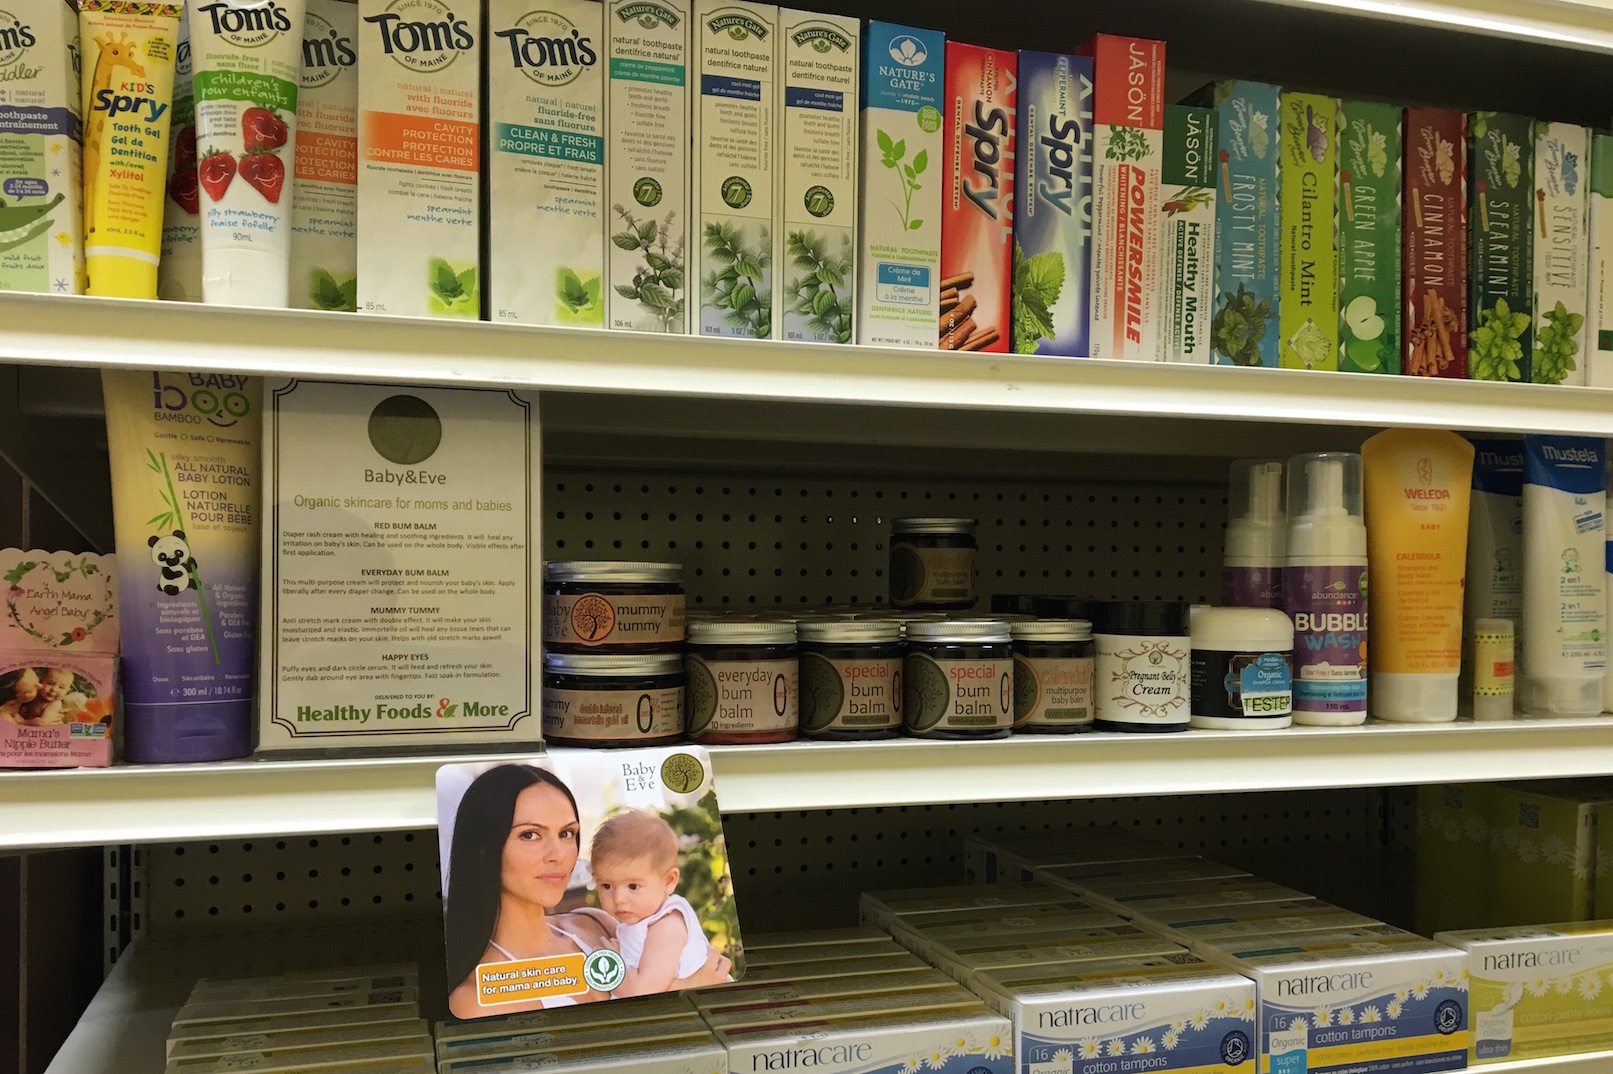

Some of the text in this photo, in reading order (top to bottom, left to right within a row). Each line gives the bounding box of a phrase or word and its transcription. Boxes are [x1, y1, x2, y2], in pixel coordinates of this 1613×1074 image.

[198, 2, 291, 34] Tom's
[712, 16, 764, 34] Nature's Gate
[230, 33, 268, 43] OF MAINE
[364, 13, 474, 54] Tom's
[796, 30, 846, 48] Nature's Gate
[495, 30, 596, 68] Tom's
[705, 46, 770, 62] natural toothpaste
[404, 54, 448, 66] OF MAINE
[708, 59, 768, 72] dentifrice naturel
[790, 60, 852, 72] natural toothpaste
[533, 69, 573, 81] OF MAINE
[792, 71, 850, 84] dentifrice naturel
[880, 66, 935, 82] NATURE'S
[120, 82, 154, 94] KID'S
[212, 74, 278, 90] children's
[890, 79, 920, 90] GATE
[202, 86, 287, 104] pour enfants
[94, 90, 168, 122] Spry
[112, 123, 160, 139] Tooth Gel
[434, 123, 472, 134] CAVITY
[112, 136, 143, 146] Gel de
[403, 130, 472, 144] PROTECTION
[511, 128, 596, 148] CLEAN & FRESH
[111, 147, 157, 162] Dentition
[403, 141, 472, 156] PROTECTION
[500, 139, 596, 160] PROPRE ET FRAIS
[367, 148, 472, 166] CONTRE LES CARIES
[964, 99, 1008, 220] Spry
[1040, 114, 1080, 216] Spry
[110, 170, 144, 181] Xylitol
[1232, 174, 1256, 279] FROSTY MINT
[1354, 186, 1376, 281] GREEN APPLE
[1301, 172, 1317, 306] Cilantro Mint
[1424, 194, 1443, 286] CINNAMON
[1488, 200, 1509, 296] SPEARMINT
[1552, 206, 1571, 288] SENSITIVE
[1126, 166, 1145, 344] POWERSMILE
[1184, 222, 1200, 354] Healthy Mouth
[154, 412, 200, 424] BAMBOO
[174, 462, 249, 476] ALL NATURAL
[178, 473, 250, 486] BABY LOTION
[364, 469, 446, 486] Baby&Eve
[183, 490, 227, 500] LOTION
[1404, 489, 1450, 498] WELEDA
[188, 502, 250, 514] NATURELLE
[294, 494, 512, 512] Organic skincare for moms and babies
[192, 512, 252, 525] POUR BÉBÉ
[392, 522, 411, 530] BUM
[362, 569, 449, 577] EVERYDAY BUM BALM
[26, 588, 91, 600] Earth Mama
[30, 607, 88, 621] Angel Baby
[618, 605, 665, 617] mummy
[618, 621, 660, 633] tummy
[1305, 633, 1361, 650] WASH
[282, 674, 304, 683] Gently
[346, 674, 357, 682] eye
[375, 672, 388, 680] with
[390, 672, 422, 682] fingertips.
[425, 672, 437, 680] Fast
[439, 672, 461, 680] soak-in
[463, 671, 501, 680] formulation.
[718, 668, 772, 685] everyday
[845, 663, 889, 682] special
[950, 664, 994, 684] special
[1129, 671, 1177, 682] Pregnant Belly
[722, 686, 752, 700] bum
[852, 683, 883, 696] bum
[957, 684, 990, 697] bum
[1133, 684, 1171, 695] Cream
[297, 698, 508, 723] Healthy Foods & More
[720, 704, 752, 718] balm
[850, 700, 884, 714] balm
[956, 700, 991, 714] balm
[18, 729, 60, 738] Mama's
[4, 740, 71, 750] Nipple Butter
[622, 762, 656, 777] Baby
[626, 779, 655, 791] Eve
[1484, 947, 1580, 971] natracare
[482, 970, 518, 982] Natural
[520, 966, 541, 978] skin
[482, 977, 579, 994] for mama and baby.
[1278, 971, 1372, 996] natracare
[1038, 1002, 1146, 1029] natracare
[1316, 1025, 1396, 1043] cotton tampons
[752, 1041, 872, 1071] natracare
[1082, 1056, 1168, 1074] cotton tampons
